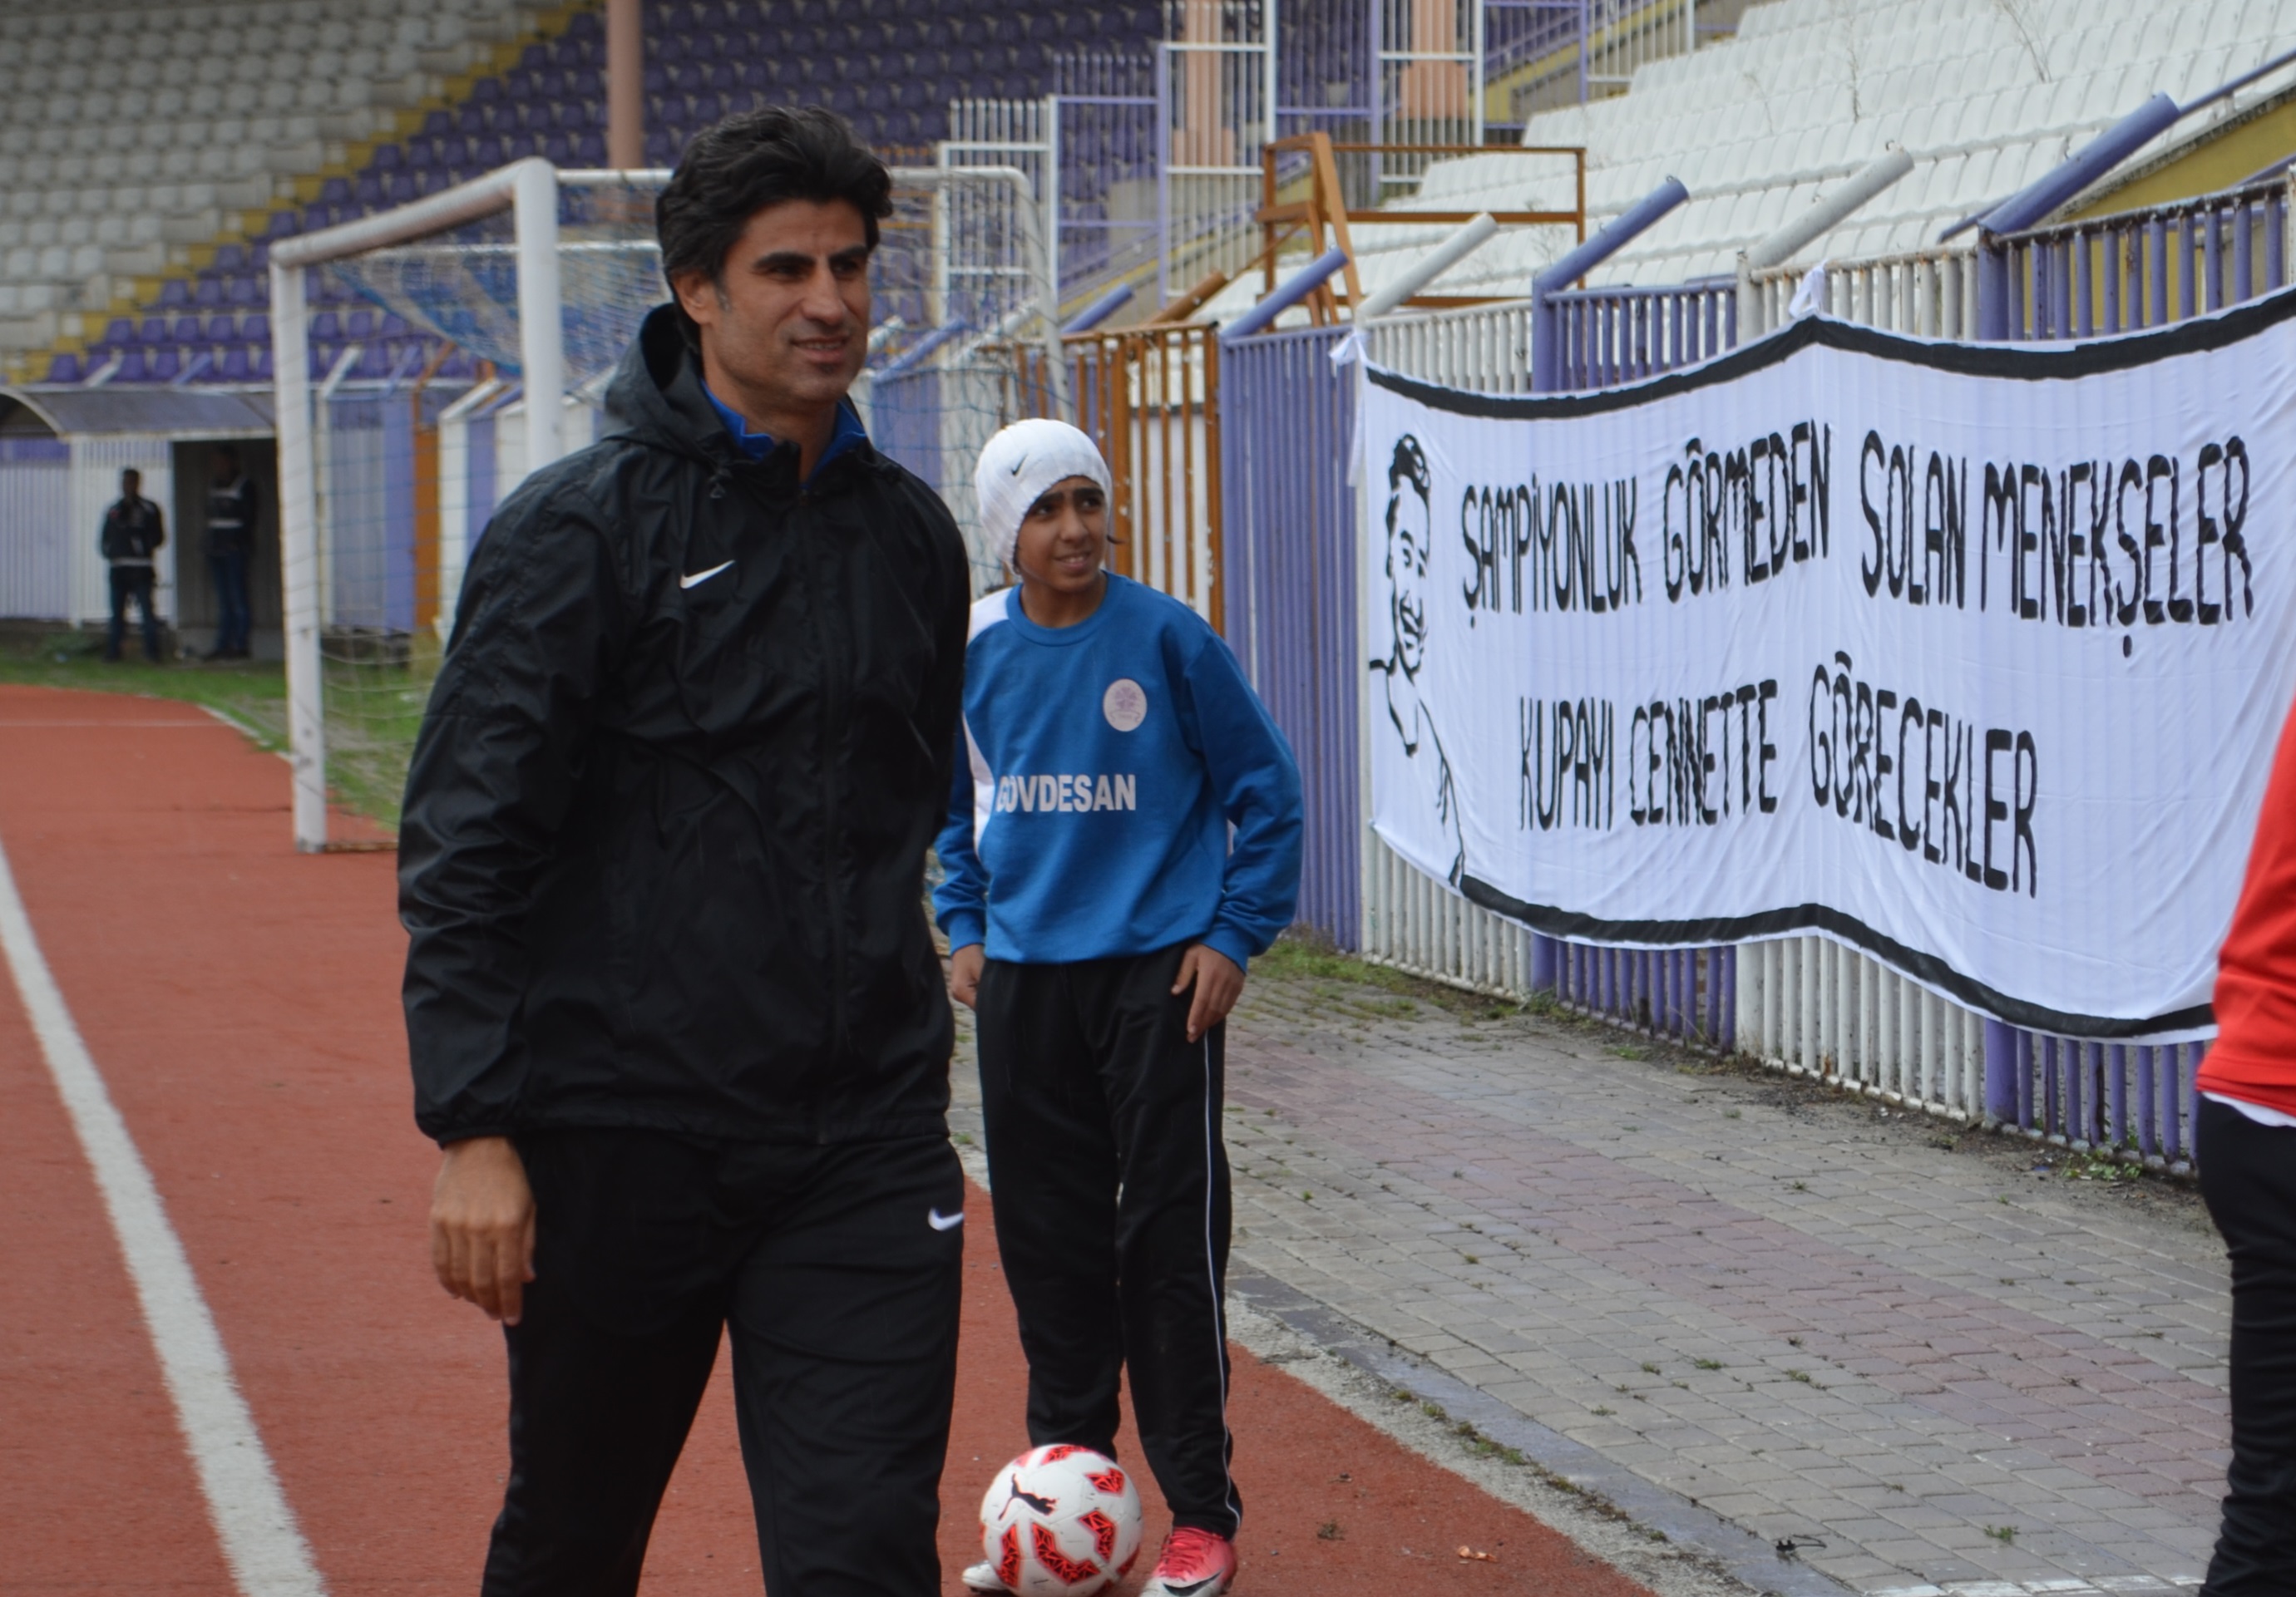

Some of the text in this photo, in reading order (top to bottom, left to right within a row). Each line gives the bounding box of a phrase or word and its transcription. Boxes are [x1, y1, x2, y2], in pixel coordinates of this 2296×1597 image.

[1860, 430, 1967, 609] SOLAN
[1520, 697, 1613, 831] KUPAYI
[1629, 678, 1777, 826] CENNETTE
